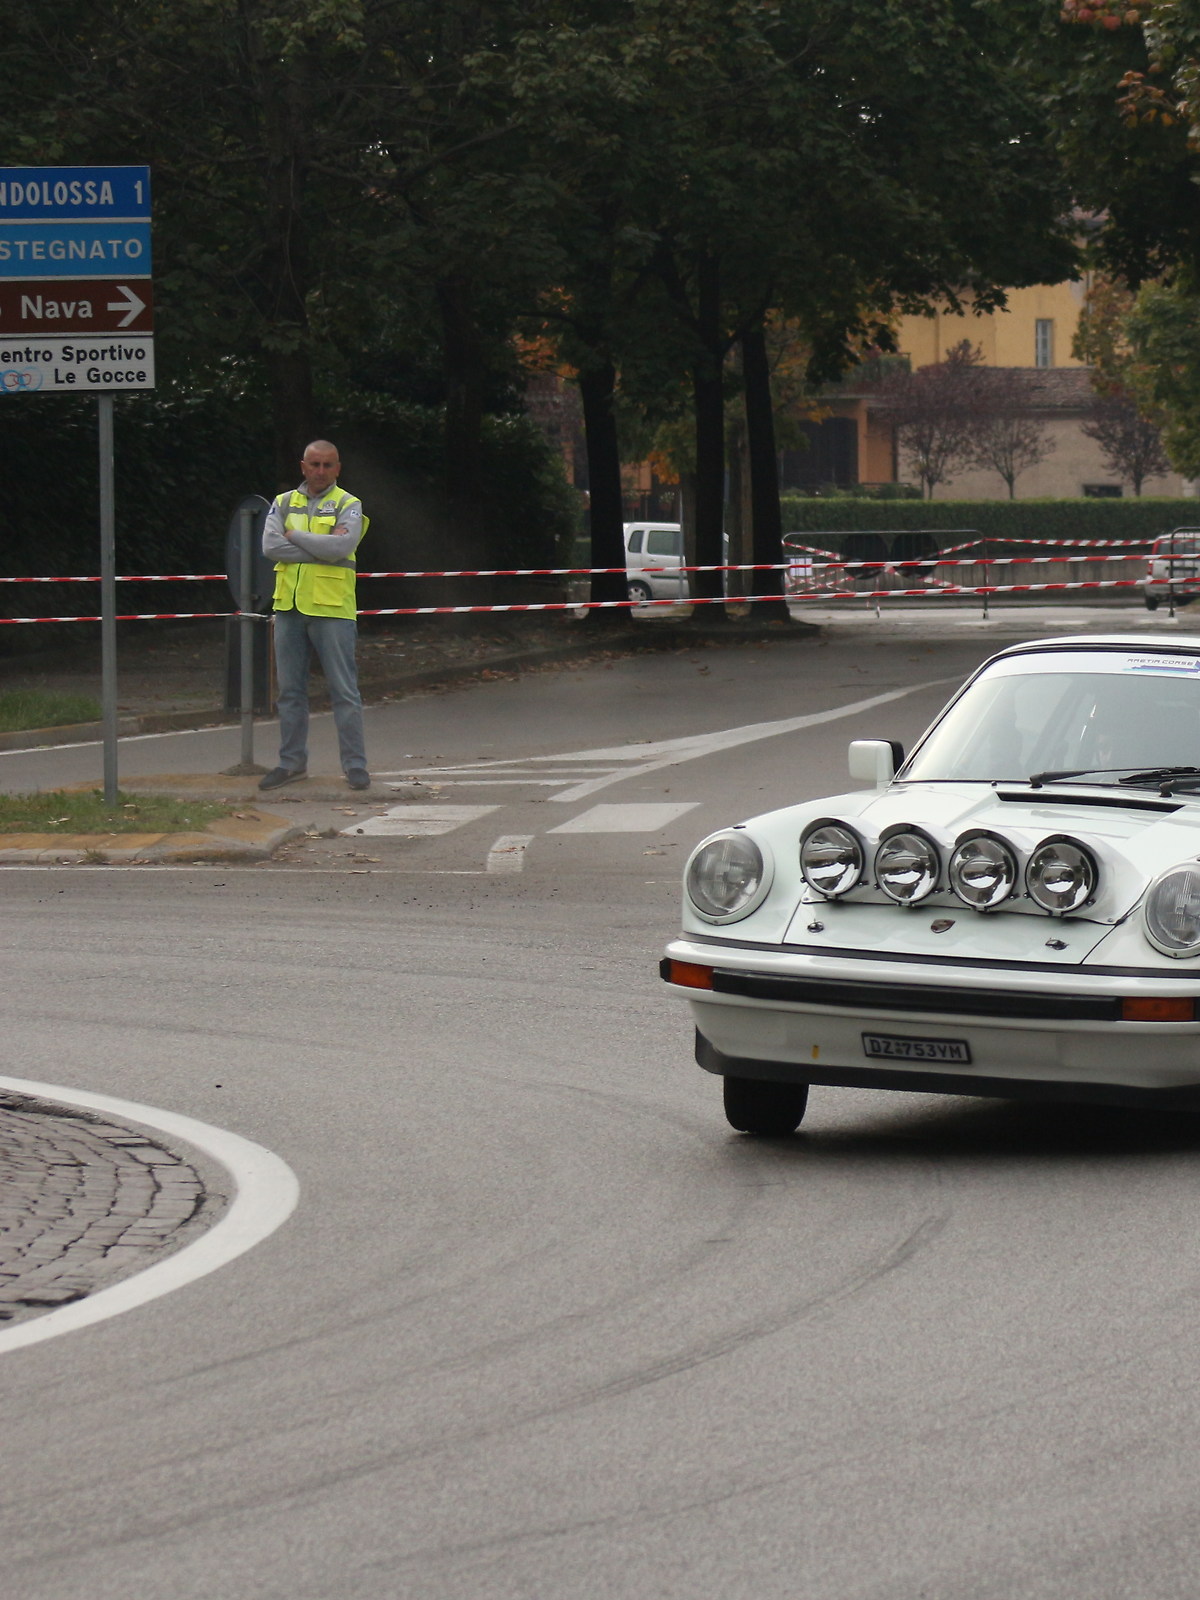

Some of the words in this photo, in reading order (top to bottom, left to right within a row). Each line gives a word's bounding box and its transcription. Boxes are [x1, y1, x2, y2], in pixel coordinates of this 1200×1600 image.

[134, 180, 143, 205] 1
[0, 238, 143, 260] STEGNATO
[21, 295, 93, 319] Nava
[1, 347, 53, 363] entro
[61, 344, 146, 364] Sportivo
[54, 368, 76, 384] Le
[87, 367, 147, 384] Gocce
